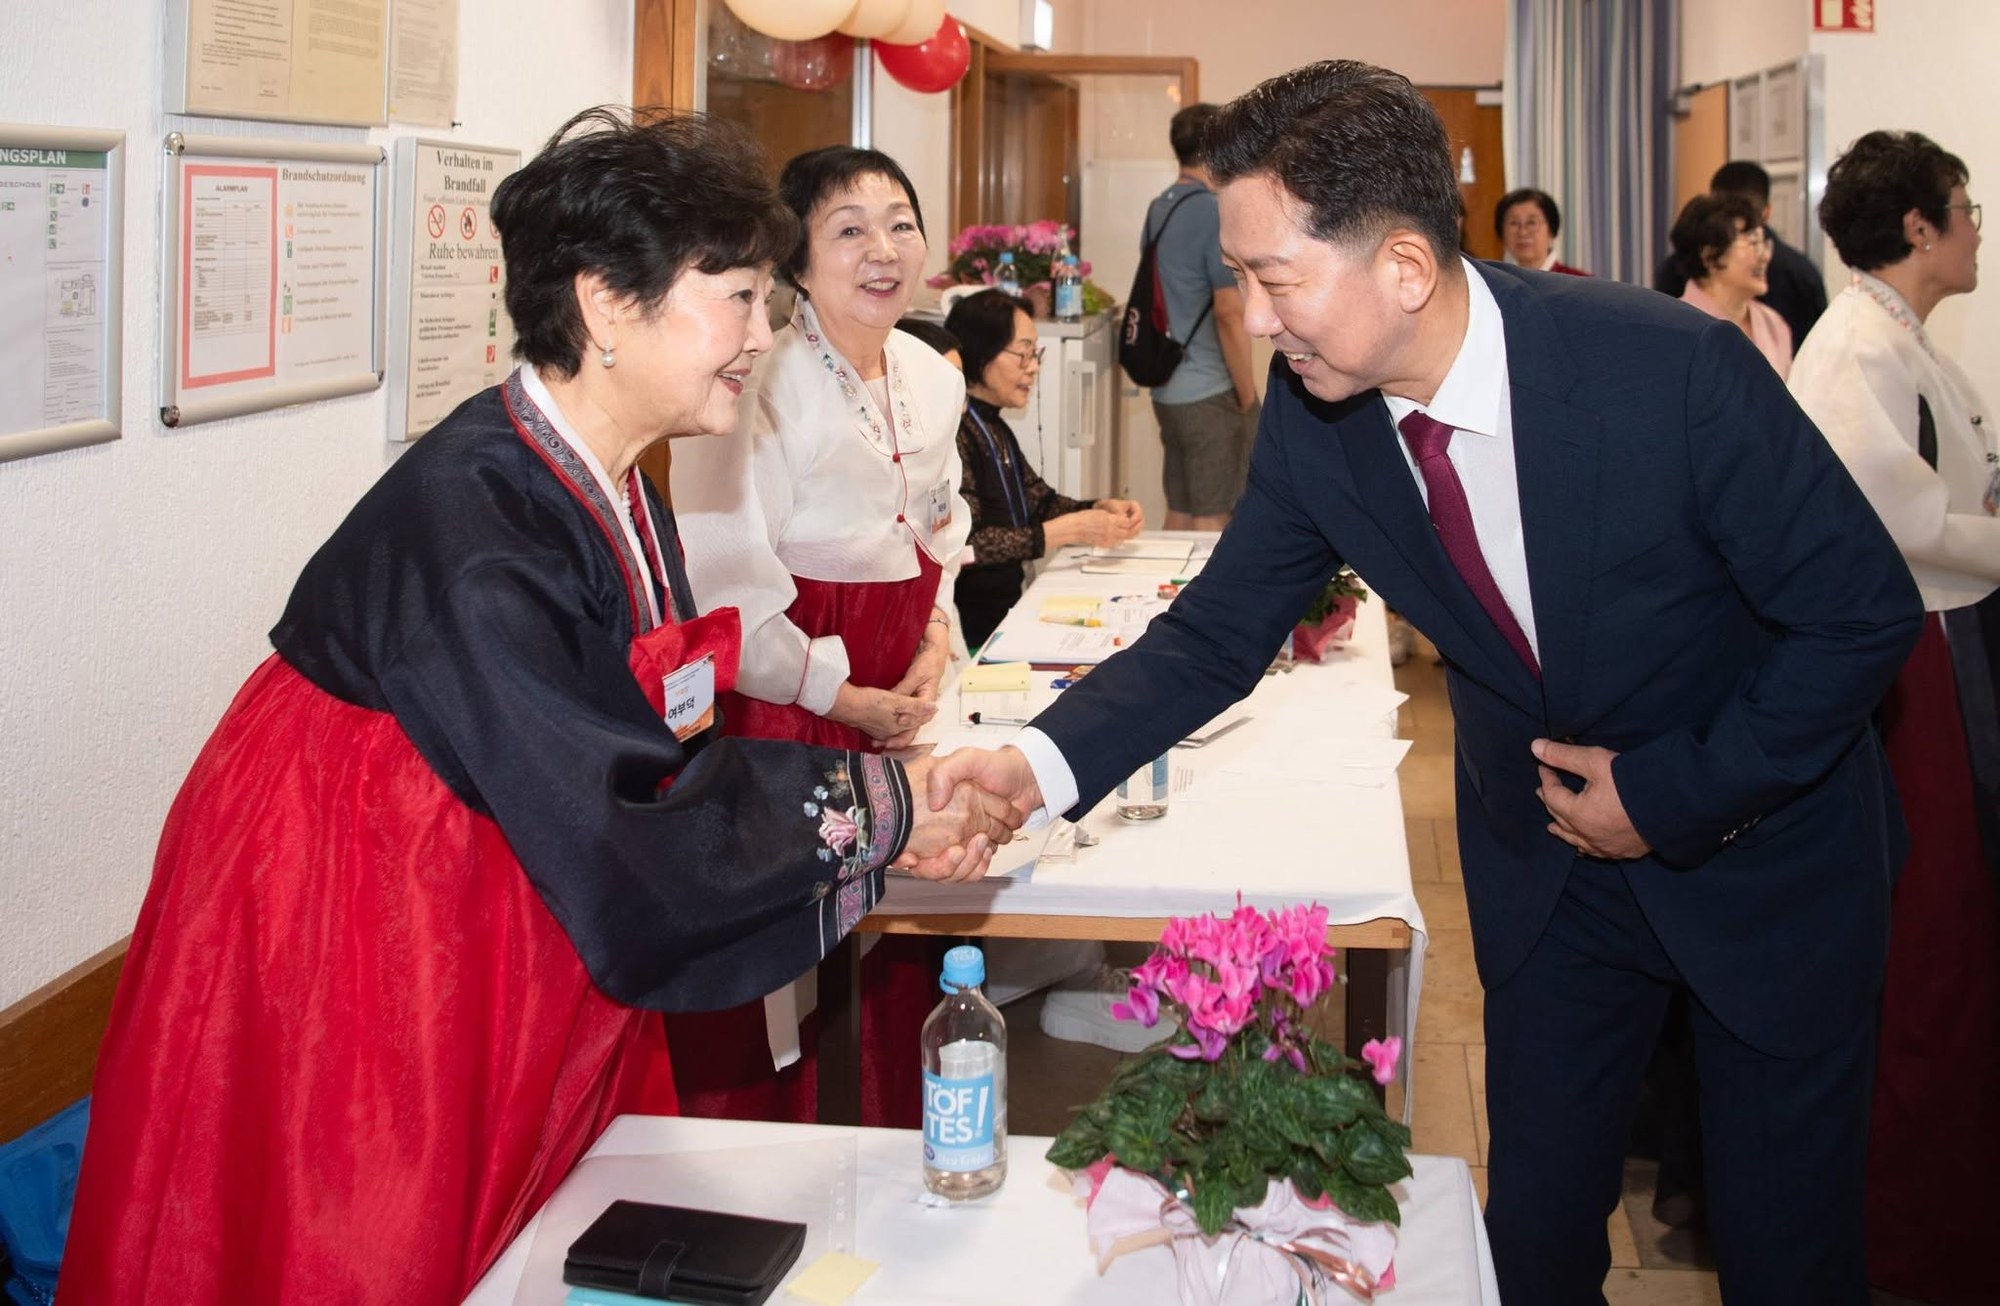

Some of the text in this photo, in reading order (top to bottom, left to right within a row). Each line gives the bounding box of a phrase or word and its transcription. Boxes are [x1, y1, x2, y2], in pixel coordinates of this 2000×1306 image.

[437, 150, 493, 171] Verhalten im
[282, 168, 366, 185] Brandschutzordnung
[444, 175, 486, 193] Brandfall
[429, 243, 498, 260] Ruhe bewahren
[668, 696, 695, 719] 여부덕
[925, 1077, 973, 1116] TÖF
